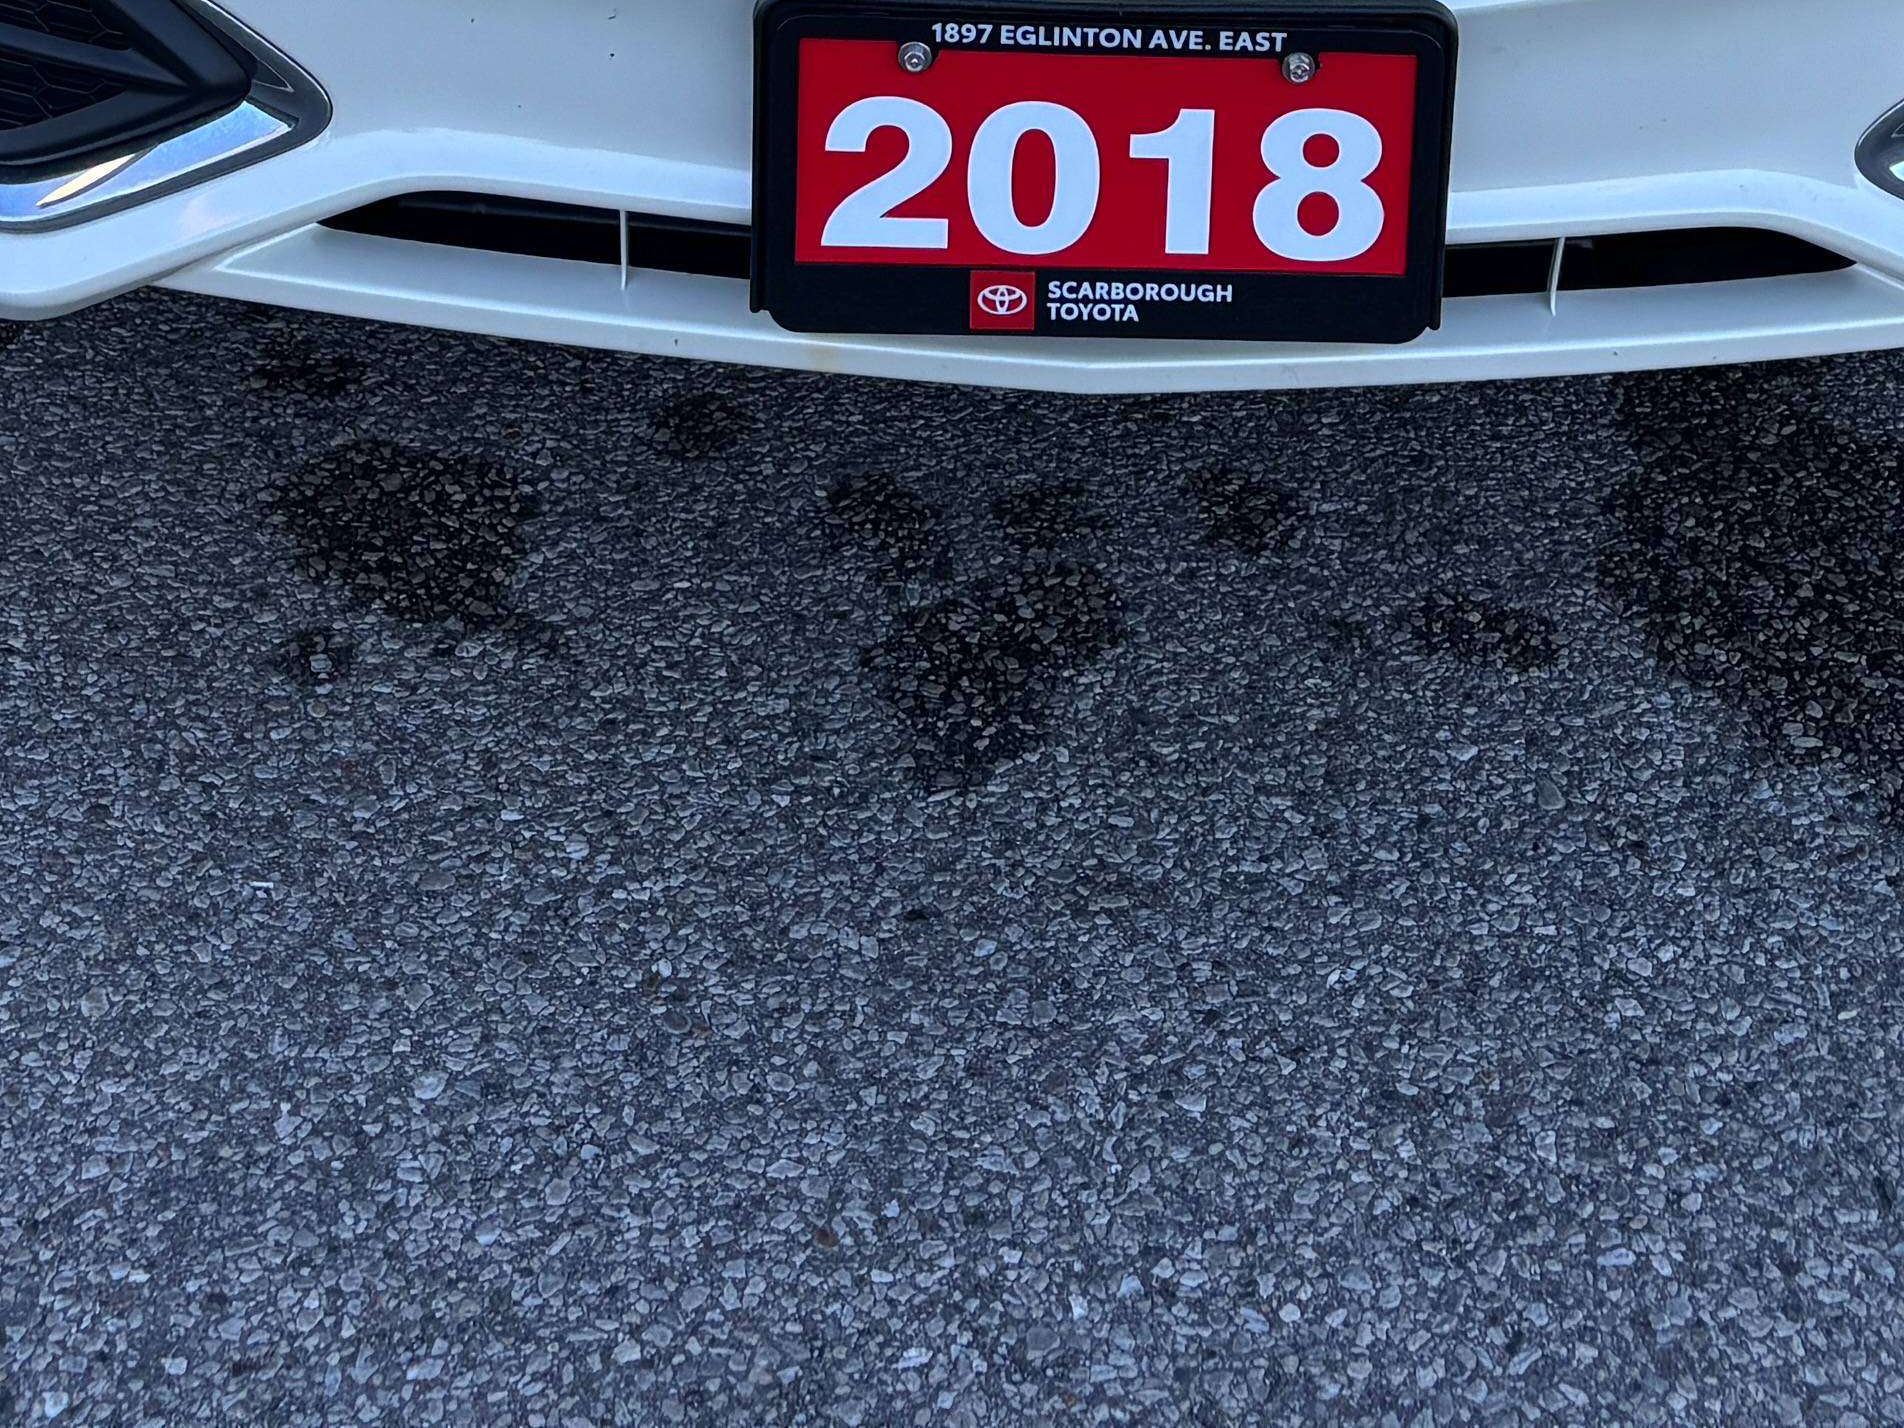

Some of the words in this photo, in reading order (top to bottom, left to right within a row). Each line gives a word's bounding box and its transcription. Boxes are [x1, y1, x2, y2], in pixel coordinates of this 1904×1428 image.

[932, 22, 993, 44] 1897
[1000, 25, 1142, 49] EGLINTON
[1148, 29, 1211, 51] AVE.
[1219, 31, 1288, 52] EAST
[821, 96, 1385, 262] 2018
[1047, 281, 1233, 303] SCARBOROUGH
[1047, 302, 1140, 322] TOYOTA
